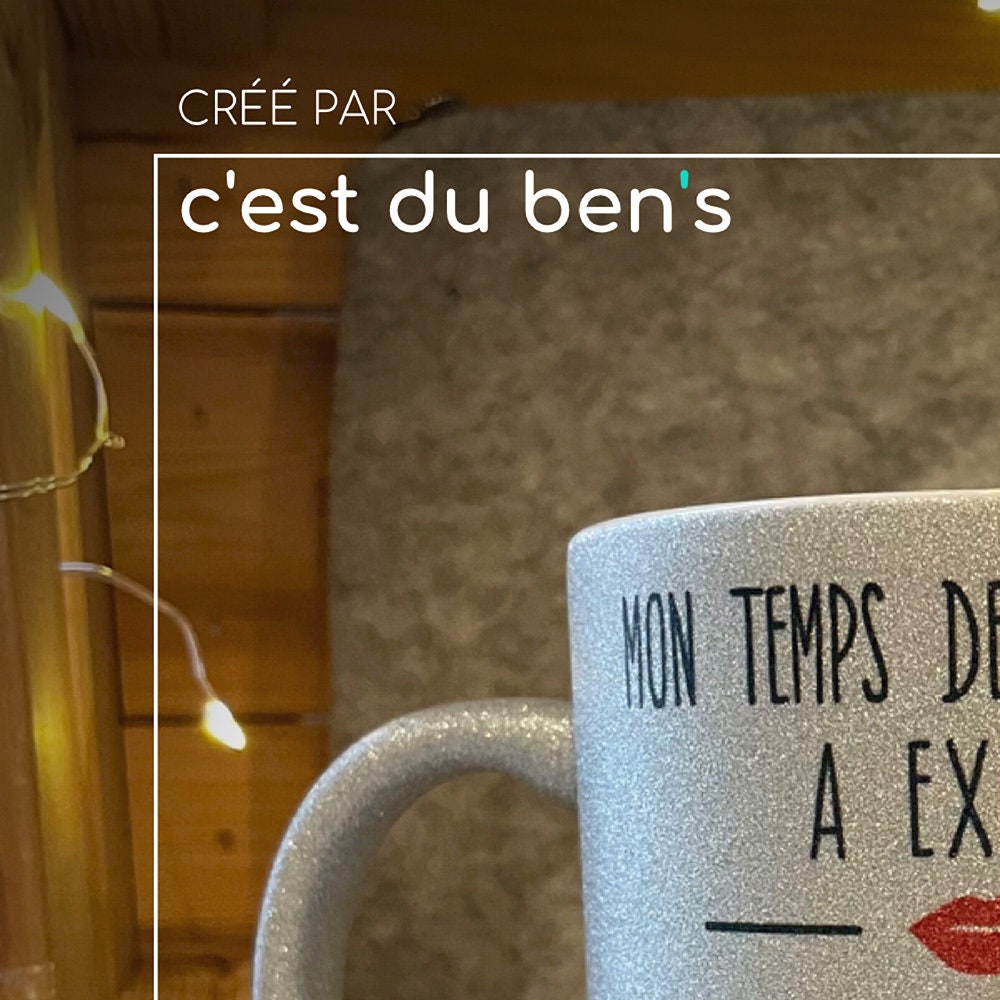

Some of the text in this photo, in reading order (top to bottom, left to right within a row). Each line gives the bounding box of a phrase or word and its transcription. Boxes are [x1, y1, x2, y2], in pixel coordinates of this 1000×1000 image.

[622, 588, 698, 710] MON
[728, 580, 890, 706] TEMPS
[810, 742, 847, 861] A
